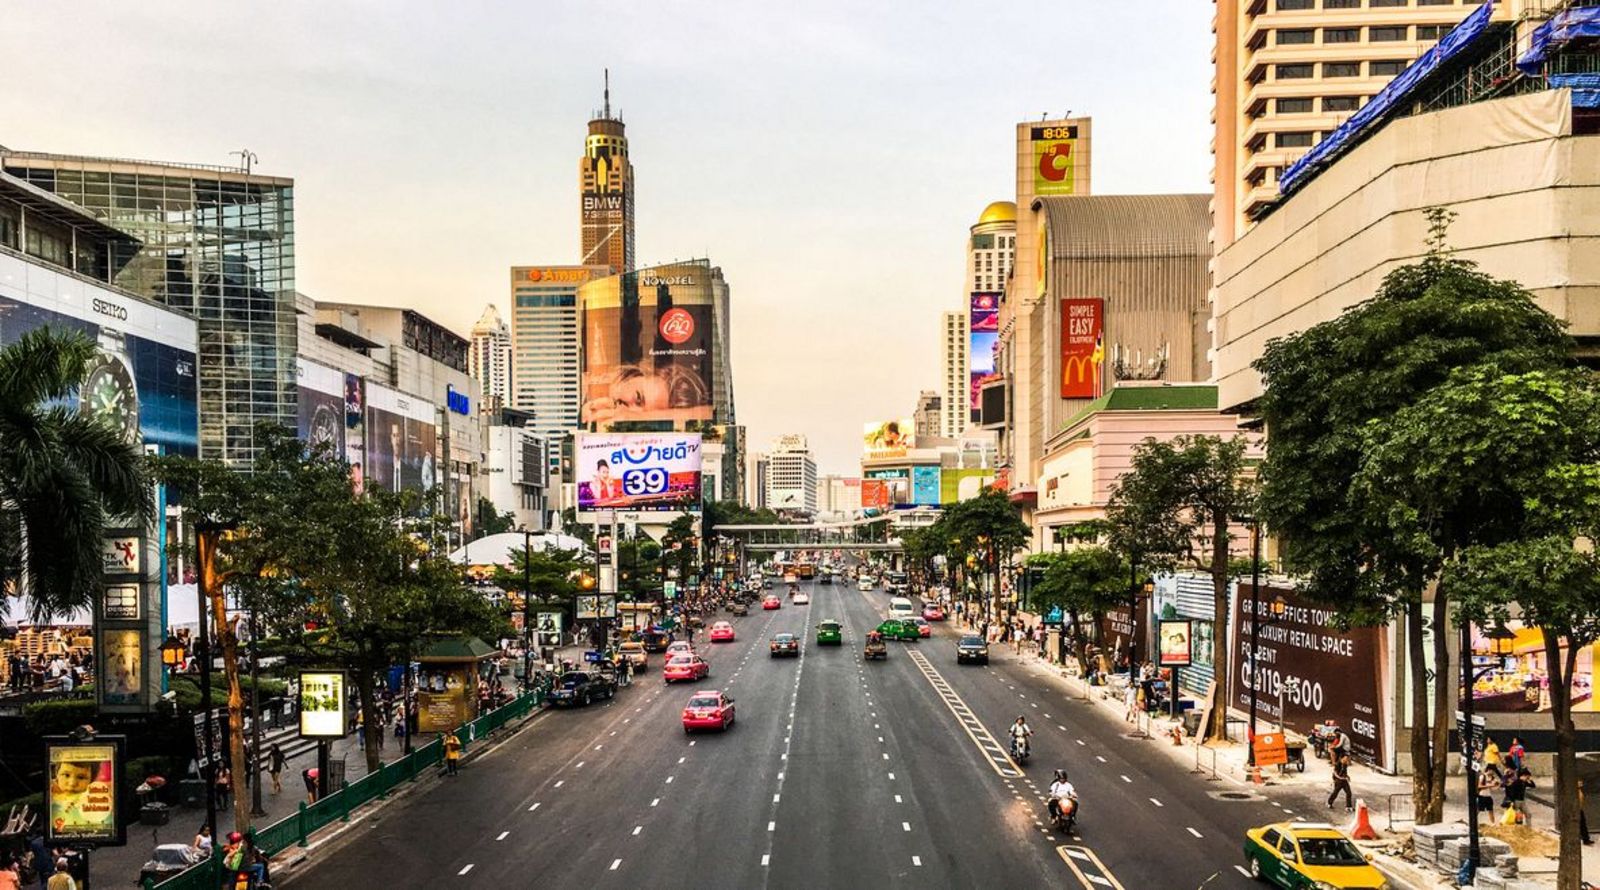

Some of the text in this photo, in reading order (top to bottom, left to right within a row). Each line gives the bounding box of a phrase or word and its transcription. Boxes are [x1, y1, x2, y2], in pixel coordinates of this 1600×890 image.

[1043, 128, 1070, 138] 18:06
[584, 197, 622, 210] BMW
[642, 276, 696, 286] NOVOTEL
[92, 297, 128, 322] SEIKO
[1069, 305, 1094, 317] SIMPLE
[1069, 318, 1094, 335] EASY
[1242, 599, 1267, 616] GRDE
[1290, 630, 1319, 650] RETAIL
[1321, 636, 1353, 657] SPACE
[1352, 718, 1375, 738] CBRE
